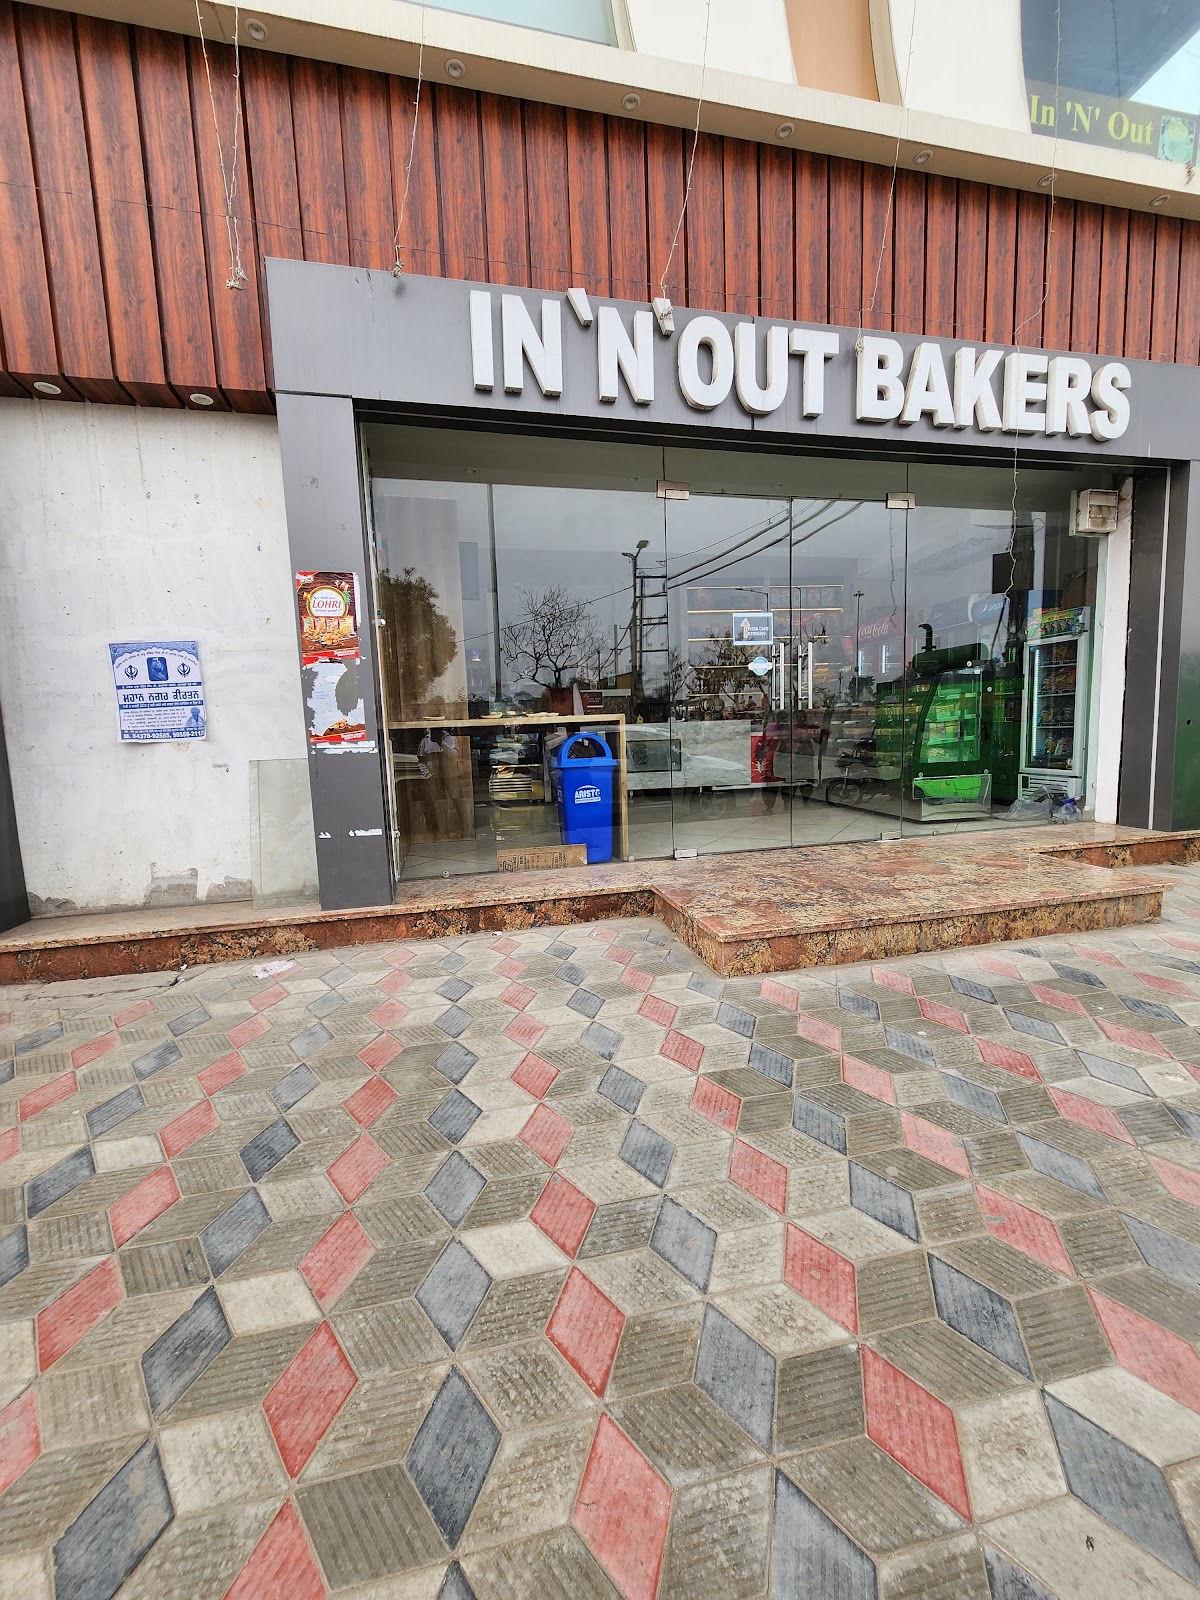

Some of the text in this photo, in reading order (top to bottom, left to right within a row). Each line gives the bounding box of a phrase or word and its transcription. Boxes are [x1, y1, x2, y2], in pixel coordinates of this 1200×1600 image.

[1029, 94, 1155, 145] In 'N' Out
[856, 335, 1132, 443] BAKERS
[312, 600, 342, 609] LOHRI
[122, 688, 200, 703] ਮਹਾਨ ਨਗਰ ਕੀਰਤਨ
